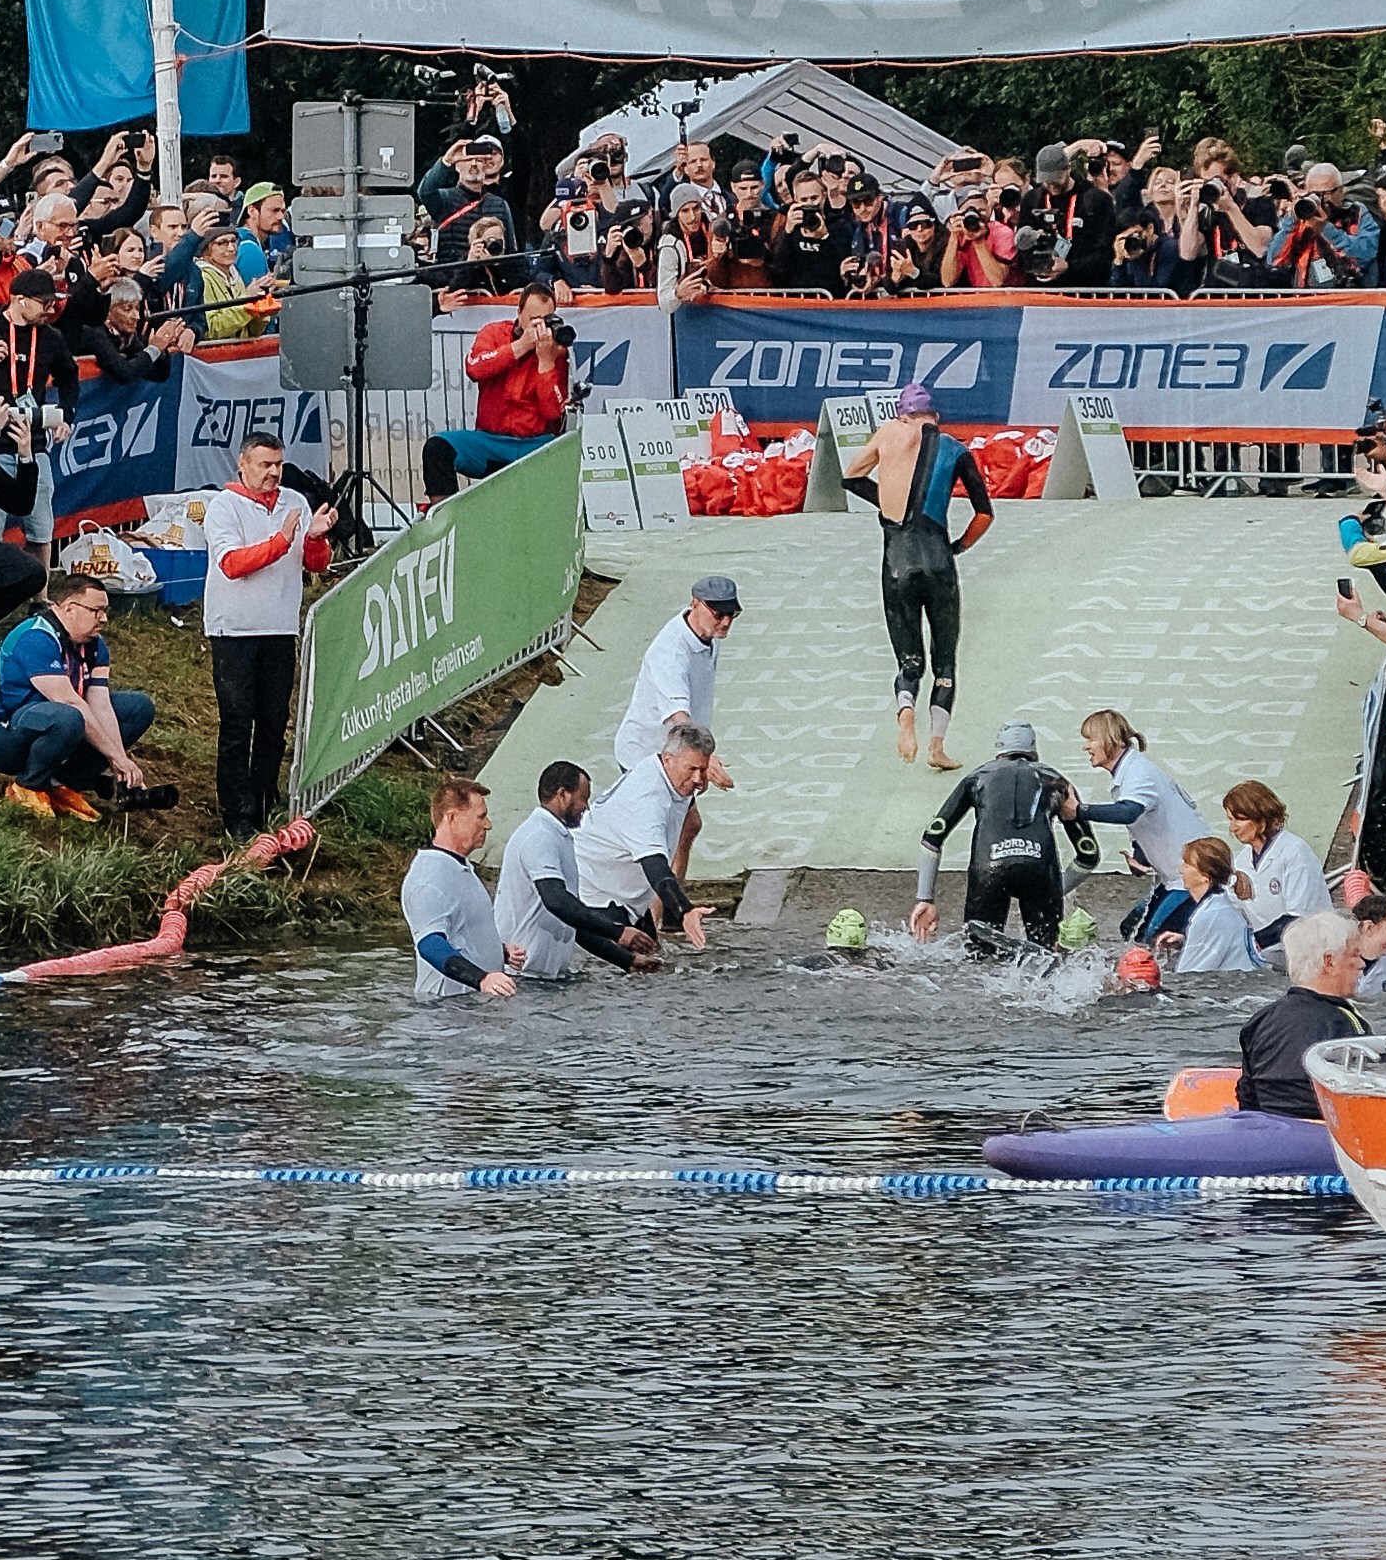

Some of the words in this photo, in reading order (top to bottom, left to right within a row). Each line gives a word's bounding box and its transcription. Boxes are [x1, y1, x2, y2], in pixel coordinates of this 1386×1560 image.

[710, 340, 903, 387] ZONE3
[1048, 342, 1250, 389] ZONE3
[836, 406, 868, 427] 2500
[1077, 396, 1114, 419] 3500
[638, 440, 673, 457] 2000
[70, 559, 120, 575] MENZEL
[358, 525, 456, 681] DATEV
[1068, 596, 1338, 611] DATEV
[1055, 621, 1340, 636] DATEV
[1041, 643, 1329, 662] DATEV
[1029, 671, 1319, 689] DATEV
[1015, 696, 1307, 716] DATEV
